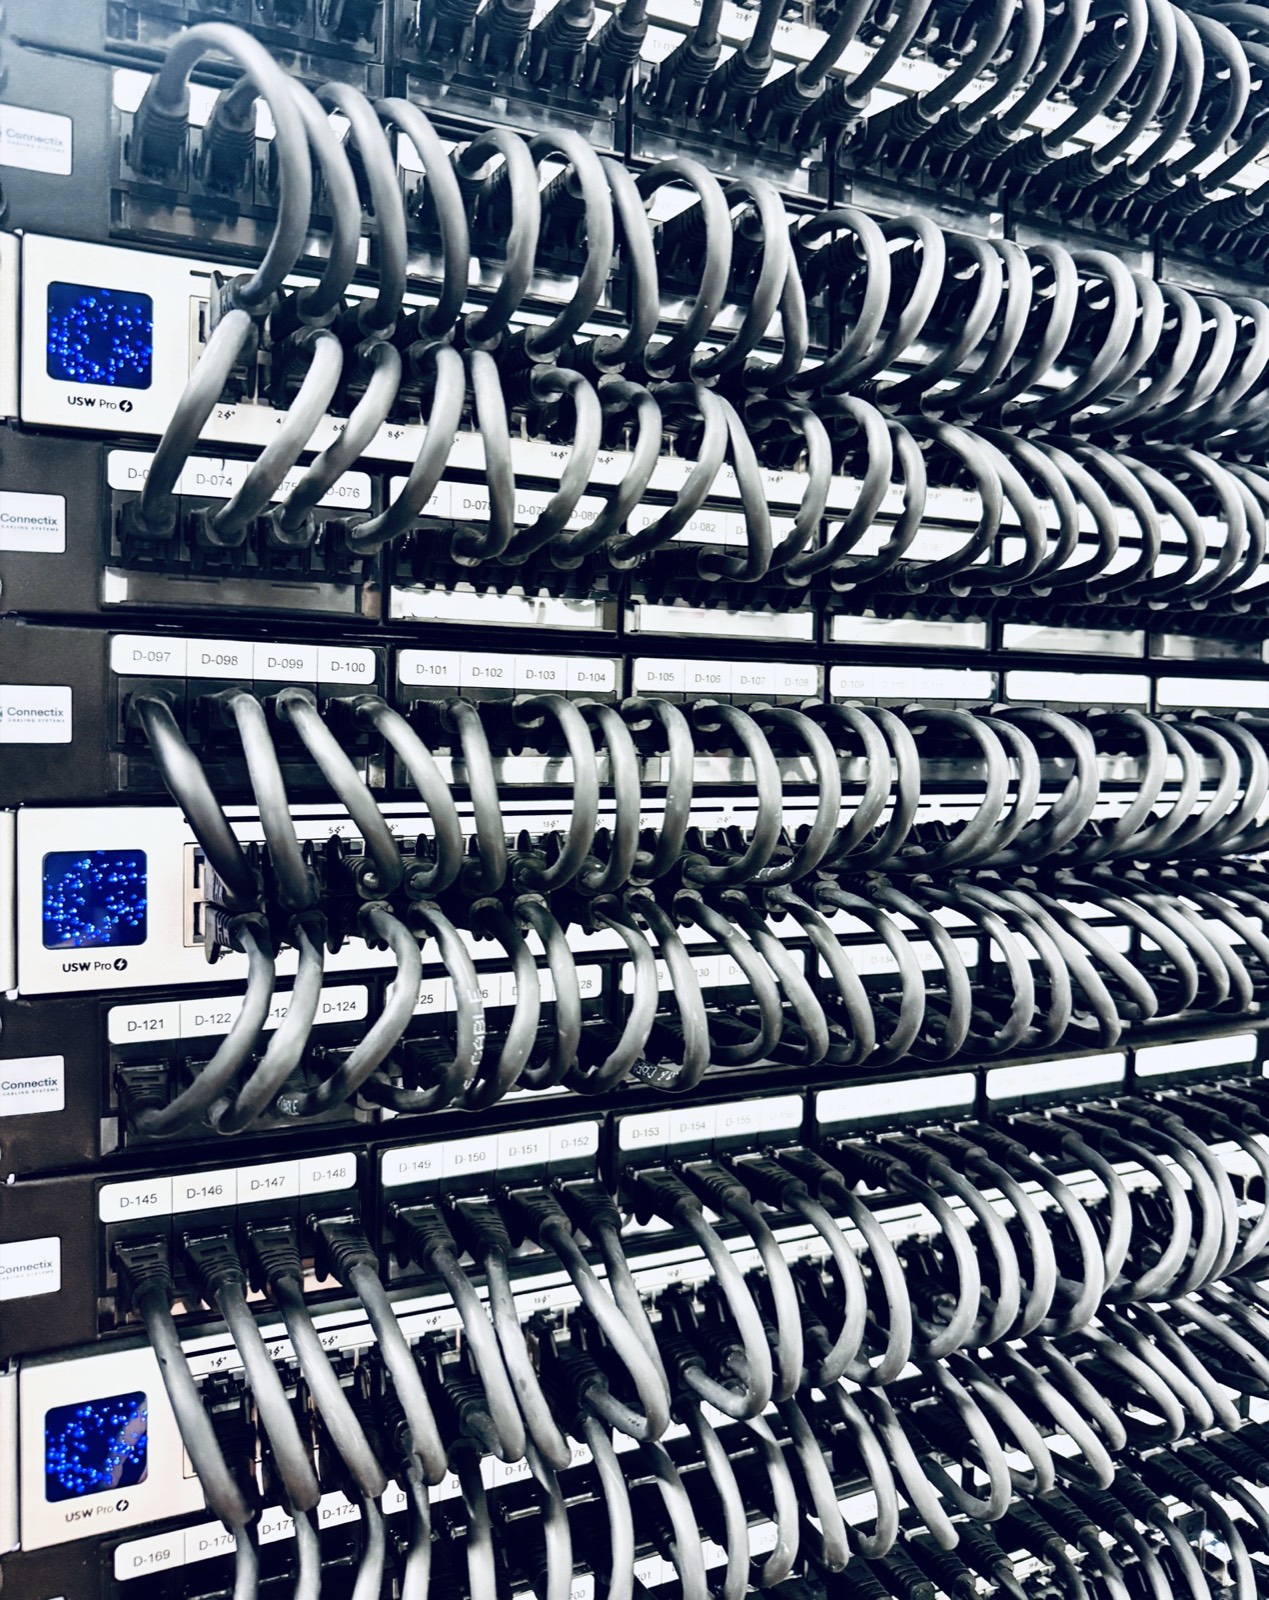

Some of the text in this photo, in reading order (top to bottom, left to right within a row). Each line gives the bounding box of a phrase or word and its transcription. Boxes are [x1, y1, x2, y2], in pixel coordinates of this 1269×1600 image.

[6, 128, 64, 146] Connectix
[67, 395, 117, 410] USW Pro
[217, 410, 223, 419] 2
[387, 430, 393, 438] 8
[196, 473, 233, 487] D-074
[0, 513, 58, 526] Connectix
[689, 521, 717, 533] D-082
[132, 650, 366, 674] D-097 D-098 D-099 D-100
[416, 664, 606, 683] D-101 D-102 D-103 D-104
[647, 671, 675, 682] D-105
[694, 673, 721, 684] D-106
[740, 675, 766, 686] D-107
[7, 706, 64, 717] Connectix
[62, 961, 112, 973] USW Pro
[127, 1018, 165, 1032] D-121
[195, 1012, 232, 1026] D-122
[322, 1000, 357, 1014] D-124
[1, 1077, 58, 1090] Connectix
[632, 1126, 660, 1139] D-153
[679, 1121, 706, 1133] D-154
[399, 1136, 589, 1173] D-149 D-150 D-151 D-152
[119, 1167, 347, 1208] D-145 D-146 D-147 D-148
[65, 1505, 114, 1522] USW Pro
[133, 1504, 355, 1567] D-169 D-170 D-171 D-172
